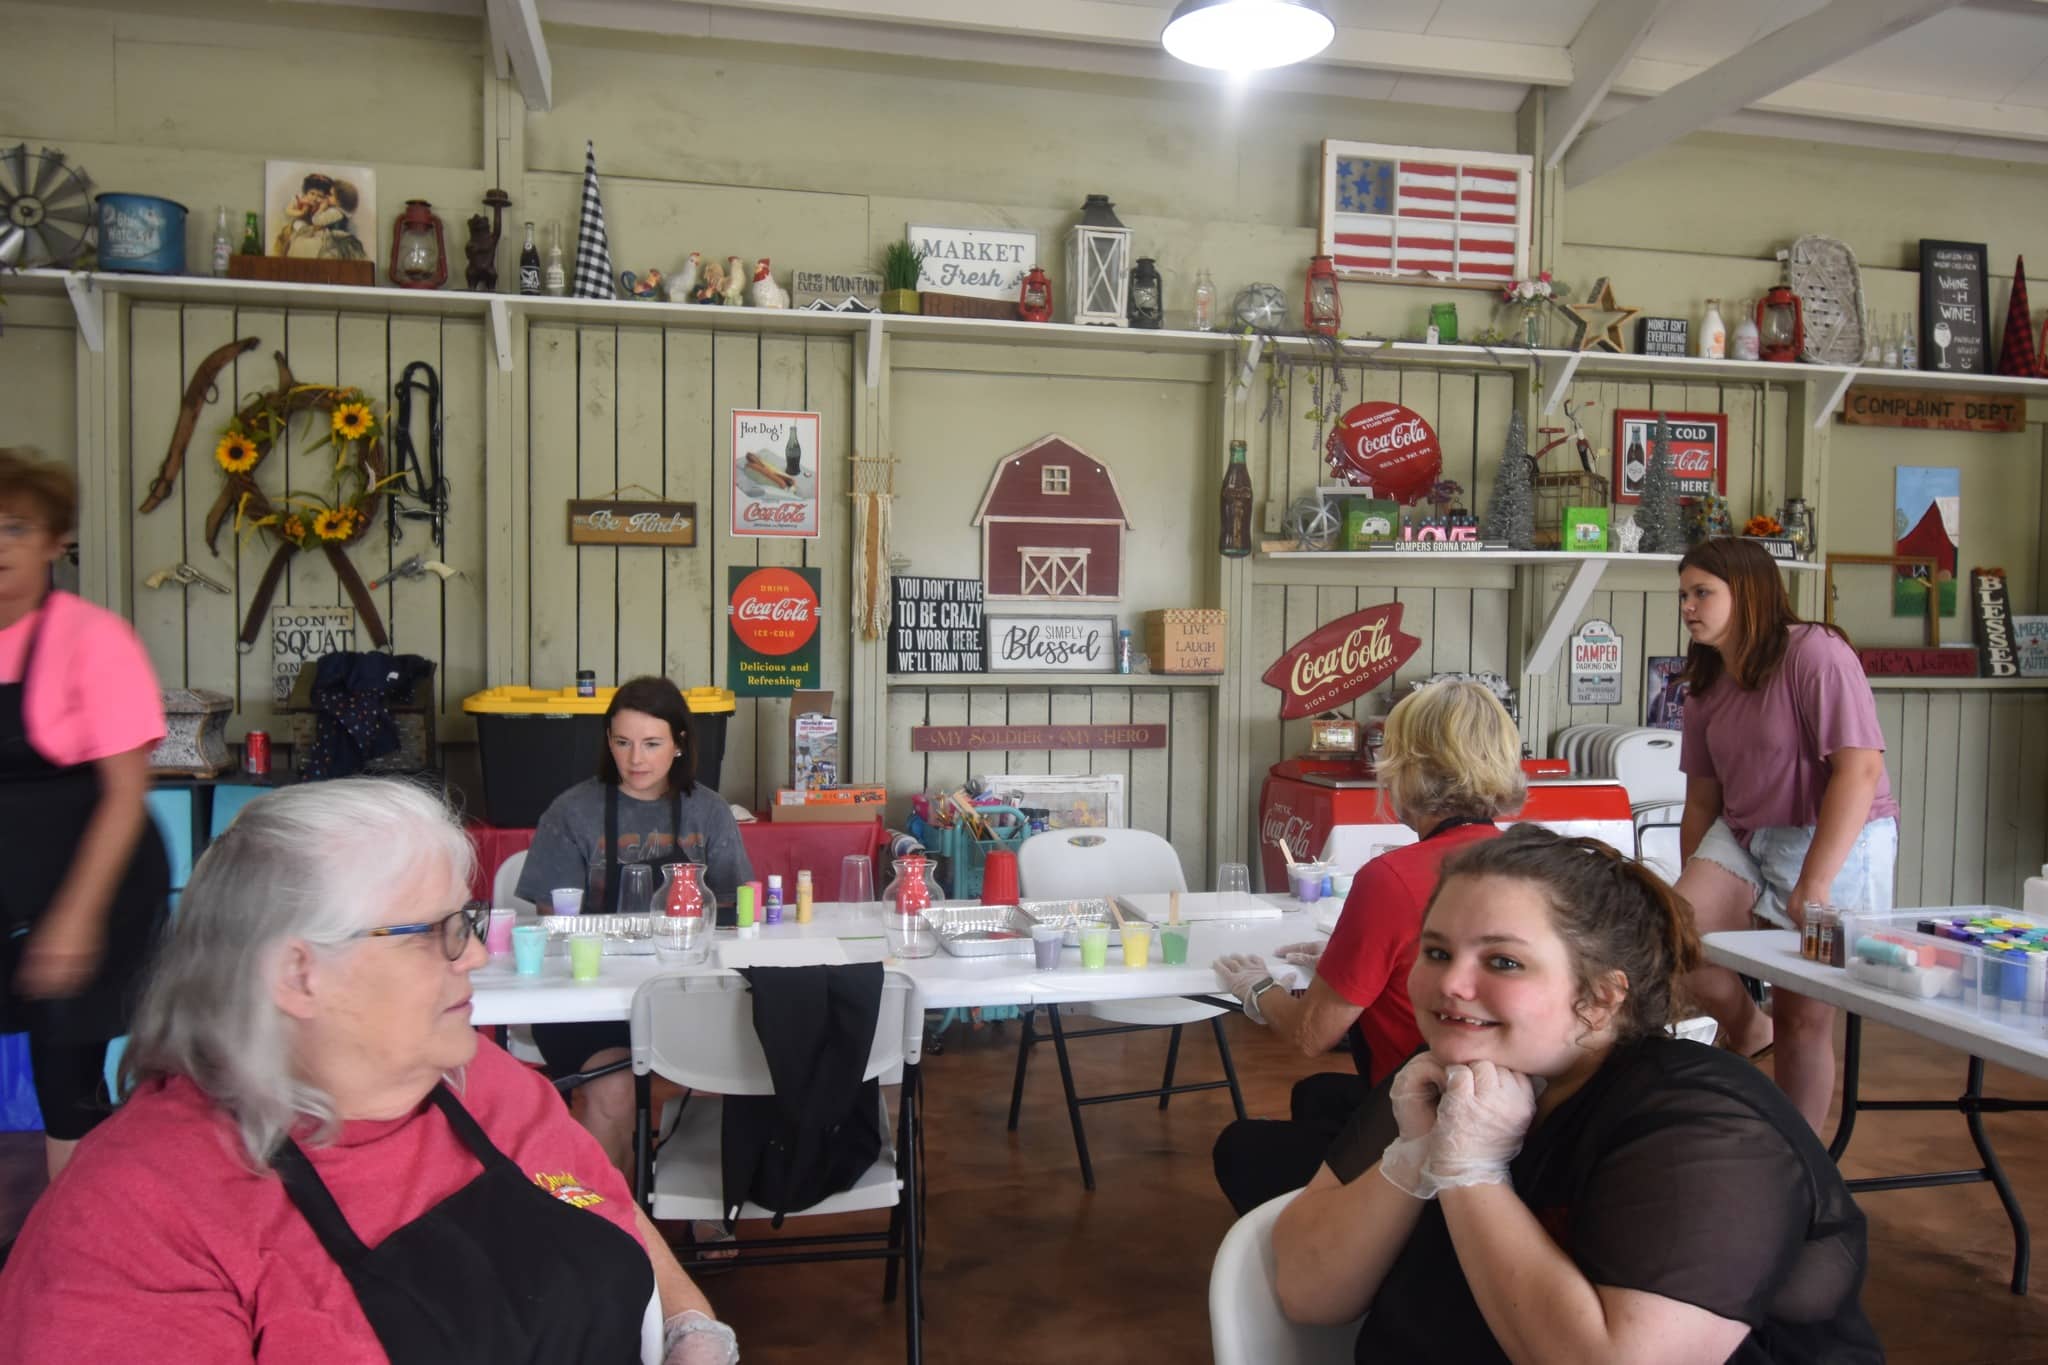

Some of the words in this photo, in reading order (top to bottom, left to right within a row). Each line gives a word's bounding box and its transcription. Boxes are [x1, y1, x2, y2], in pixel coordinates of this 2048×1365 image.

[922, 239, 1025, 263] MARKET
[825, 274, 880, 295] MOUNTAIN
[940, 263, 1004, 288] Fresh
[1938, 275, 1969, 290] WHINE
[1940, 306, 1977, 324] WINE!
[1647, 319, 1669, 331] MONEY
[1670, 320, 1687, 333] ISN'T
[1647, 331, 1686, 343] EVERYTHING
[1853, 395, 1955, 417] COMPLAINT
[1964, 402, 2018, 422] DEPT.
[741, 421, 758, 438] Hot
[759, 423, 783, 441] Dog!
[1357, 418, 1427, 459] Coca-Cola
[1675, 427, 1707, 440] COLD
[1681, 480, 1709, 493] HERE
[588, 509, 620, 531] Be
[624, 512, 682, 533] Kind
[743, 502, 807, 523] Coca-Cola
[1404, 516, 1479, 541] LOVE
[1395, 542, 1431, 551] CAMPERS
[1433, 542, 1458, 551] GONNA
[1460, 543, 1483, 552] CAMP
[1764, 541, 1795, 558] CALLING
[899, 578, 920, 600] YOU
[922, 579, 955, 601] DON'T
[956, 581, 983, 602] HAVE
[738, 597, 810, 621] Coca-Cola
[899, 601, 916, 628] TO
[919, 602, 937, 629] BE
[941, 602, 983, 629] CRAZY
[279, 615, 349, 627] DON'T
[1183, 624, 1209, 635] LIVE
[1978, 576, 2017, 676] BLESSED
[899, 629, 913, 650] TO
[915, 629, 949, 651] WORK
[952, 631, 983, 651] HERE.
[1045, 626, 1084, 640] SIMPLY
[275, 629, 354, 660] SQUAT
[1002, 625, 1101, 664] Blessed
[1176, 641, 1216, 652] LAUGH
[1576, 645, 1618, 662] CAMPER
[899, 652, 928, 672] WE'LL
[930, 652, 959, 672] TRAIN
[961, 652, 983, 672] YOU.
[1181, 657, 1211, 668] LOVE
[1291, 615, 1392, 696] Coca-Cola
[277, 663, 300, 673] ON
[740, 661, 786, 672] Delicious
[790, 662, 809, 672] and
[1576, 662, 1602, 670] PARKING
[1602, 662, 1617, 670] ONLY
[747, 675, 801, 688] Refreshing
[1304, 695, 1326, 710] SIGN
[1328, 687, 1341, 697] OF
[1343, 672, 1369, 689] GOOD
[1372, 656, 1399, 673] TASTE
[934, 730, 960, 746] MY
[968, 729, 1041, 746] SOLDIER
[1062, 729, 1089, 745] MY
[1103, 728, 1149, 744] HERO
